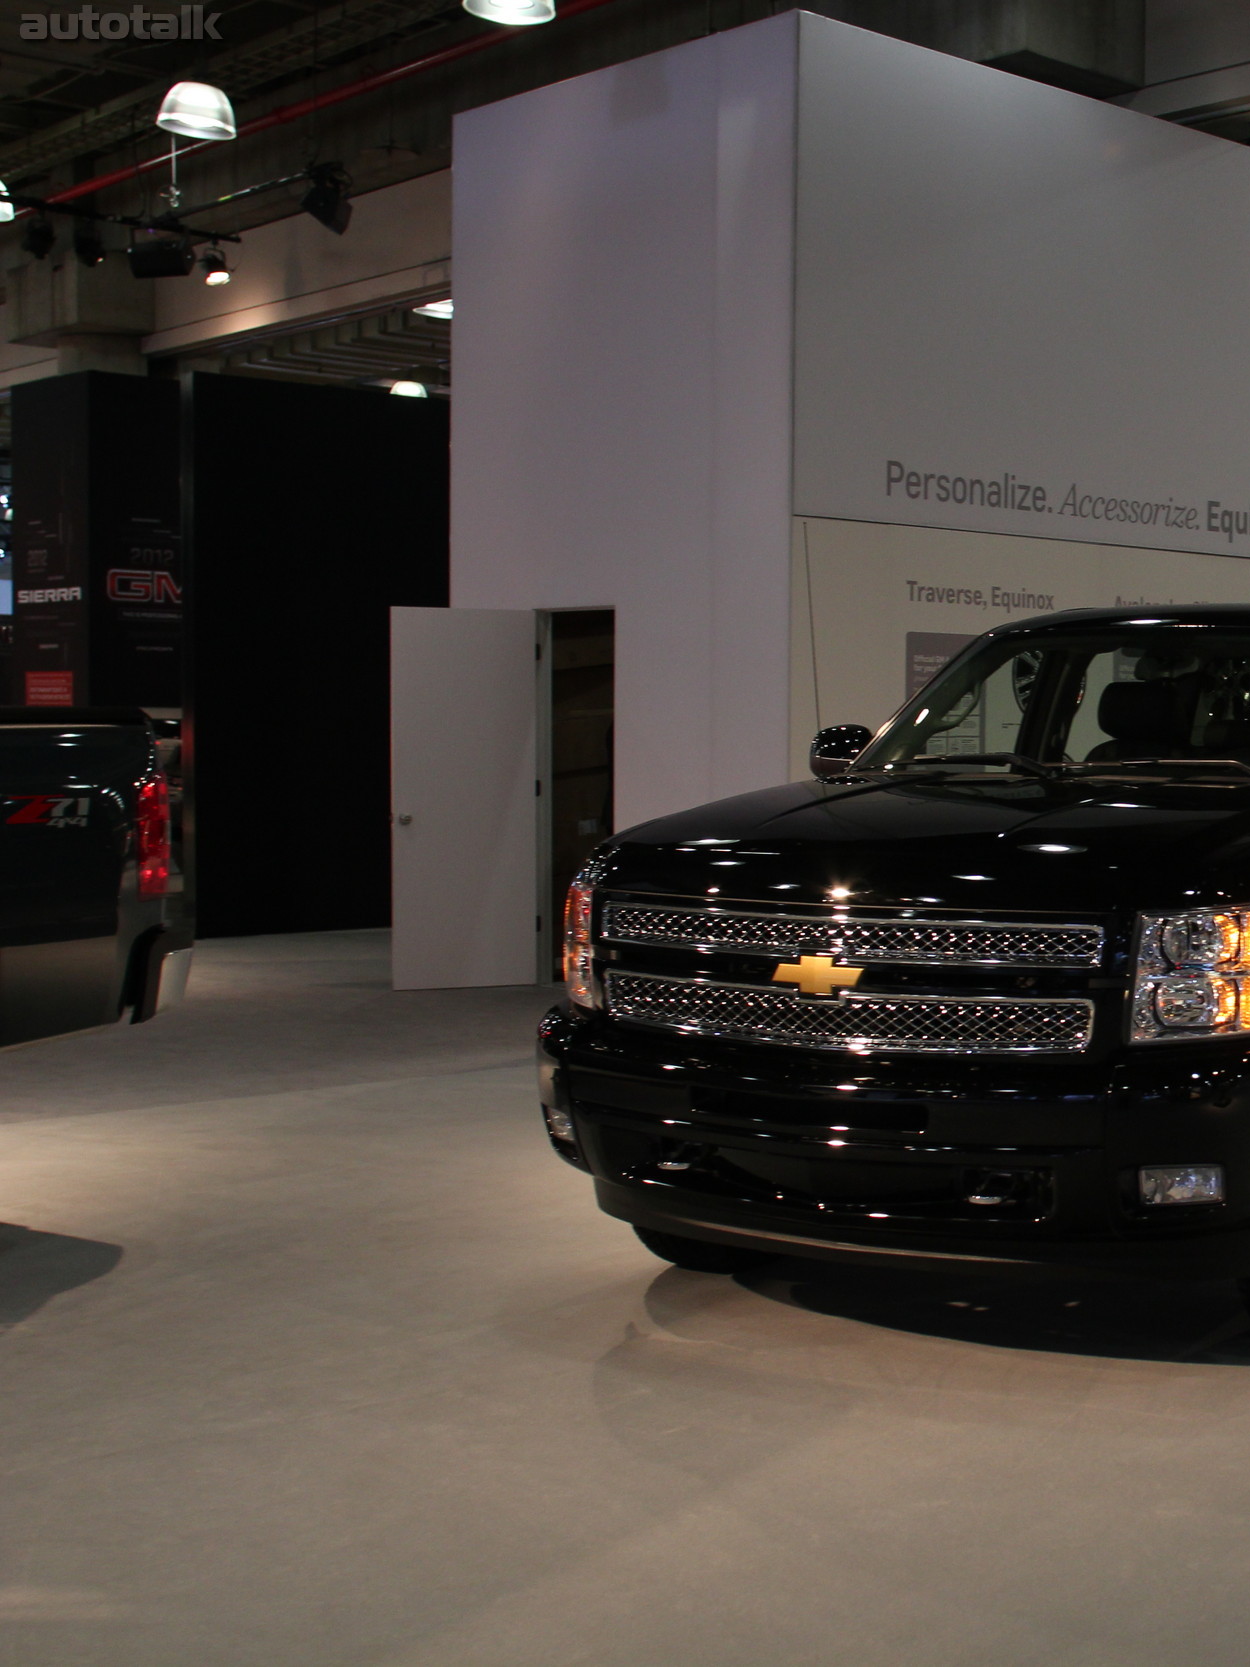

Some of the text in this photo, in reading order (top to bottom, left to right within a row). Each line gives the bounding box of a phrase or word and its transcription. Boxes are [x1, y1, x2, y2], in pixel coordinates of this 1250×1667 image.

[886, 460, 1053, 515] Personalize.
[1056, 483, 1201, 531] Accessorize.
[17, 586, 82, 604] SIERRA
[905, 580, 1055, 615] Traverse, Equinox
